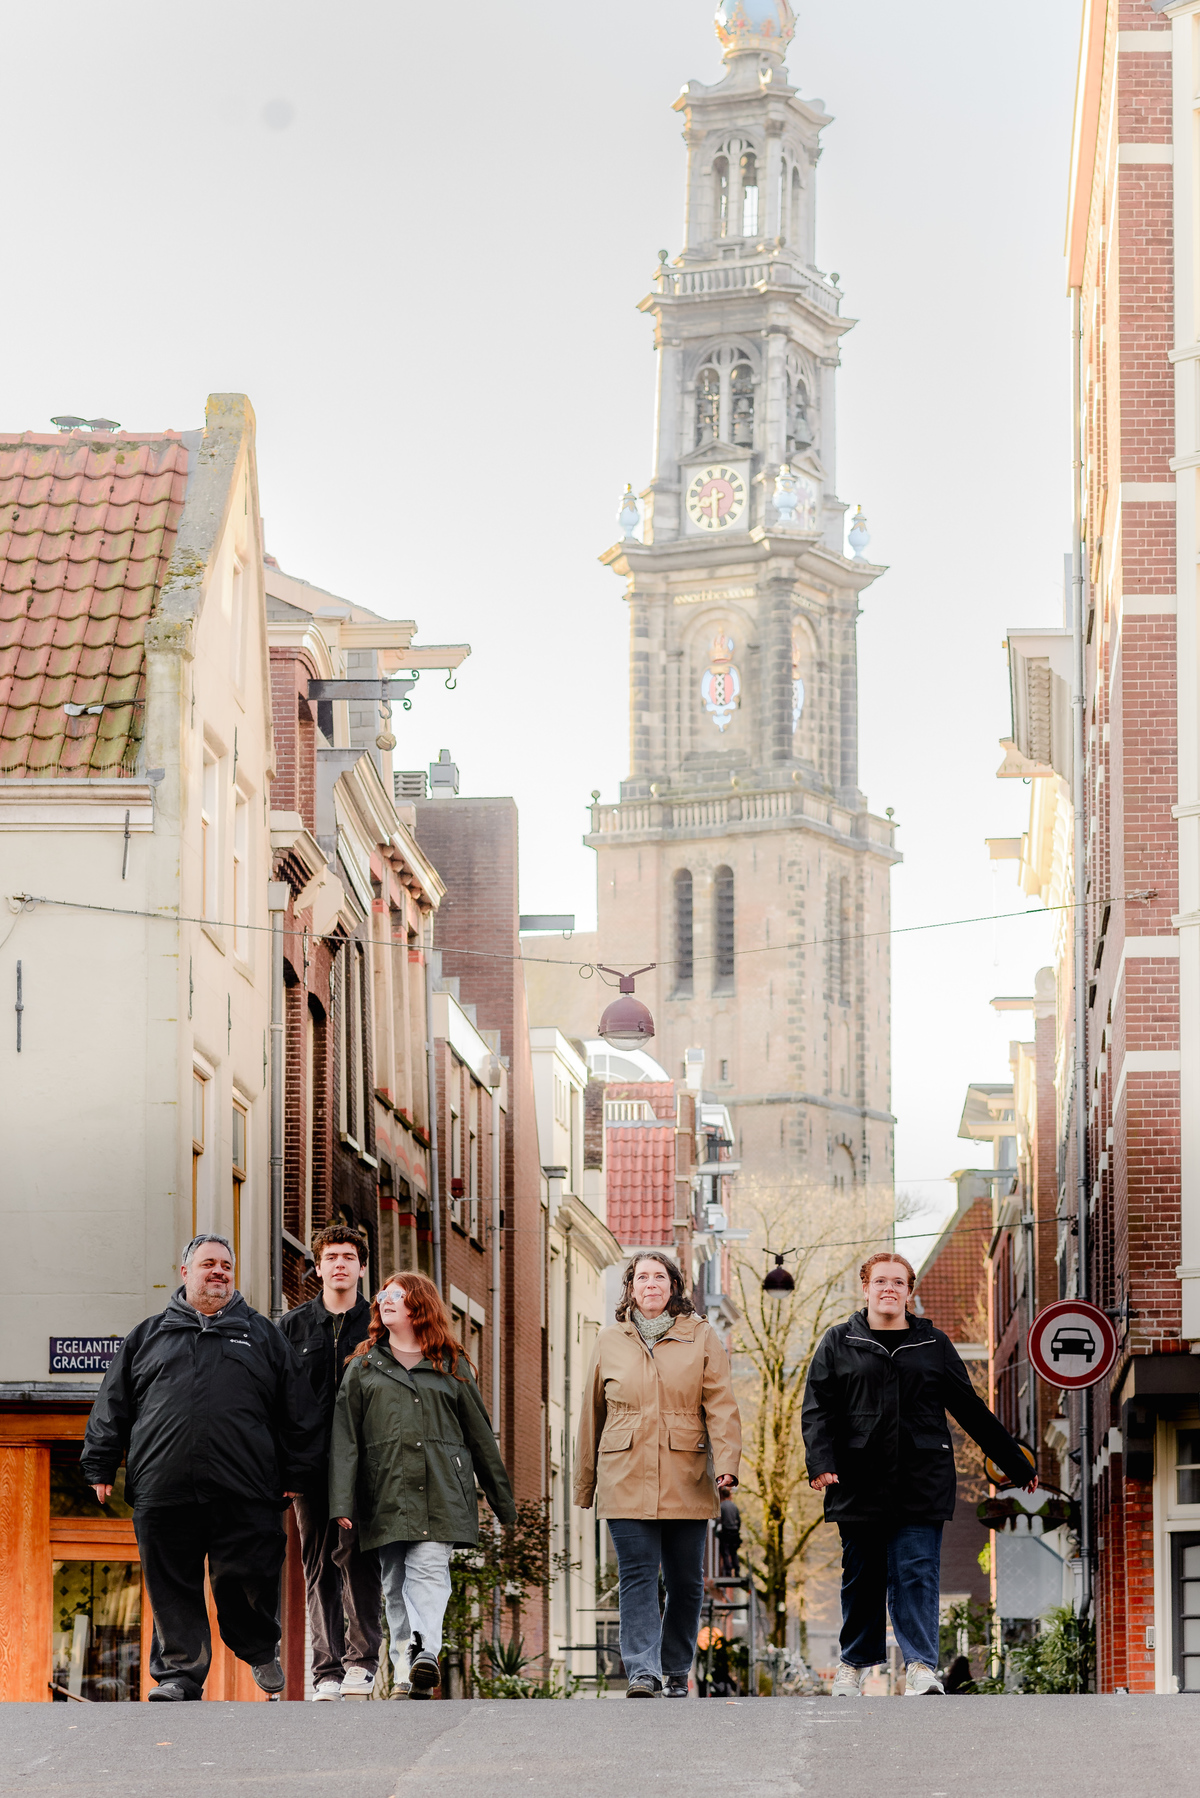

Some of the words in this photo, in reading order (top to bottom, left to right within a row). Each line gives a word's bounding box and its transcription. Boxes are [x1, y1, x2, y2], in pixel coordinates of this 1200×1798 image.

[56, 1340, 124, 1354] EGELANTIE
[53, 1356, 101, 1369] GRACHT
[101, 1360, 113, 1369] CE
